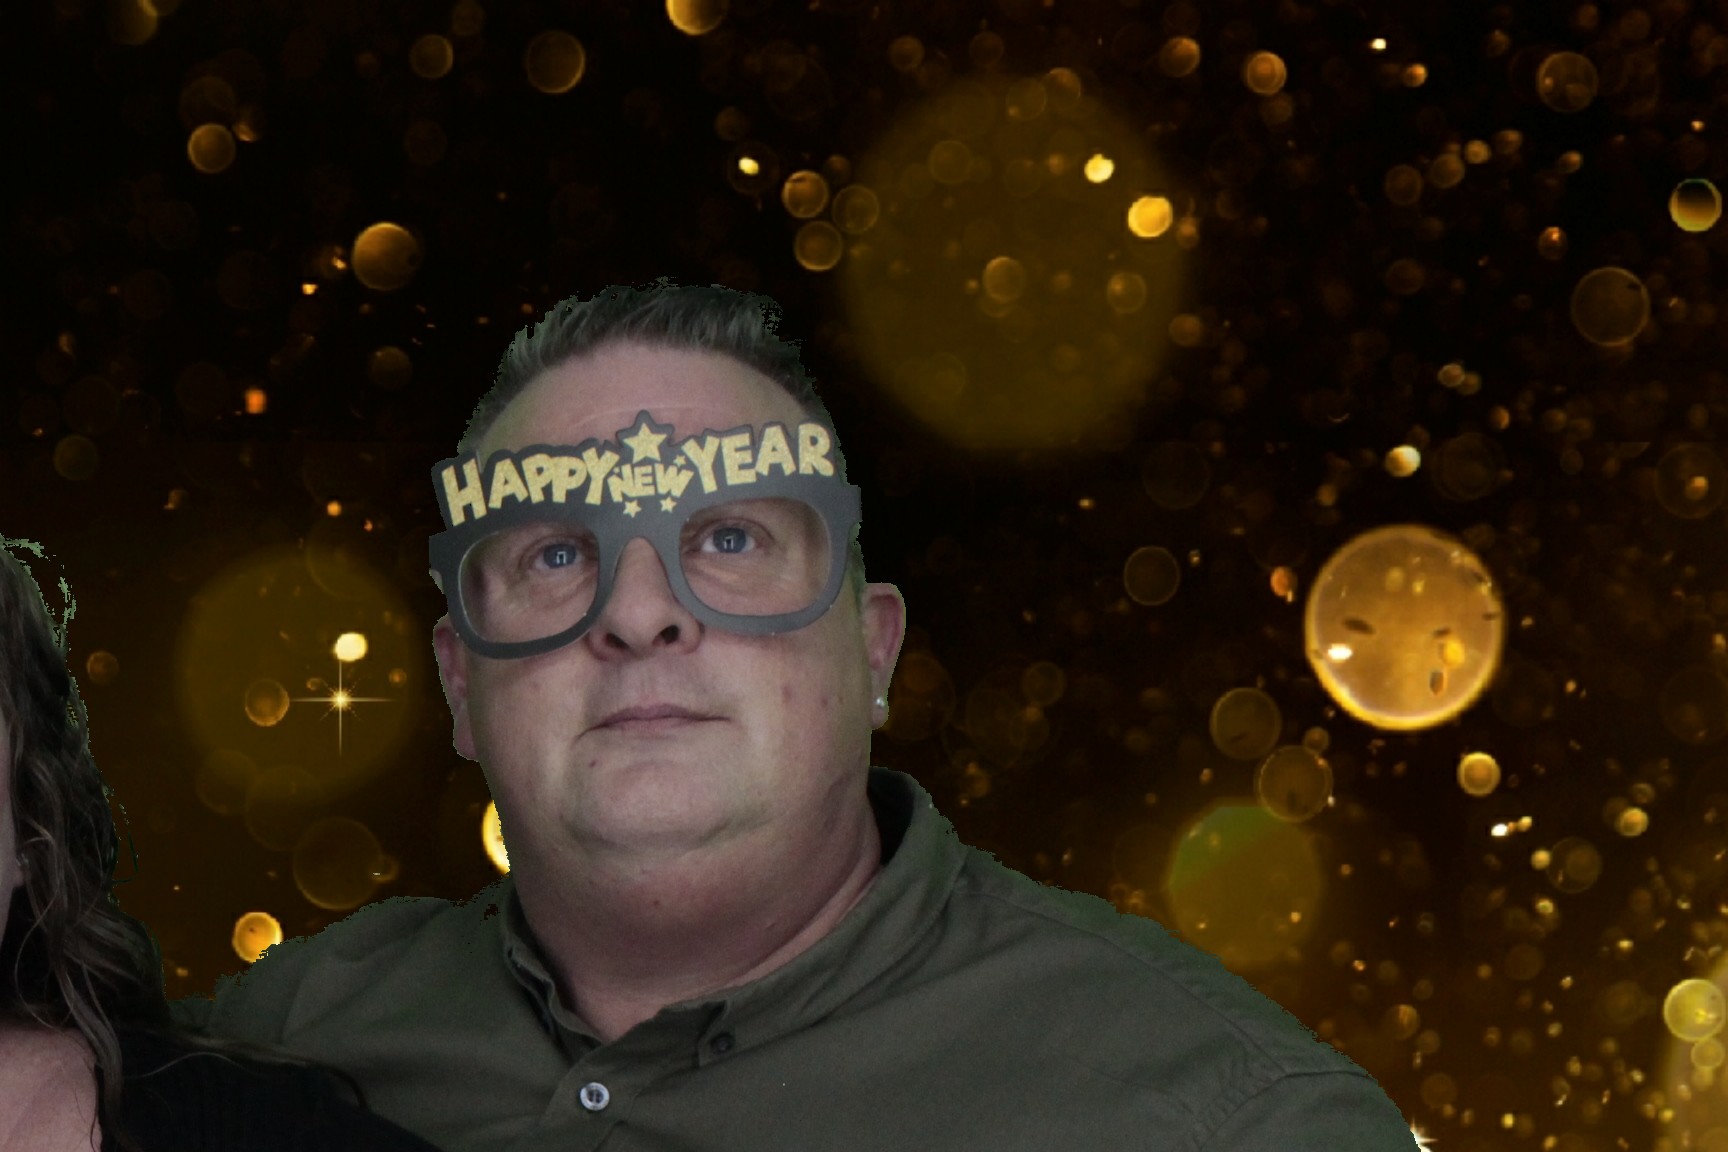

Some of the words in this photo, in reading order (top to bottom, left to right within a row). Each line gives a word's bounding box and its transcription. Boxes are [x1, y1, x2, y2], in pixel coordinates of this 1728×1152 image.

[441, 447, 619, 526] HAPPY
[609, 462, 693, 500] NEW
[682, 423, 834, 493] YEAR
